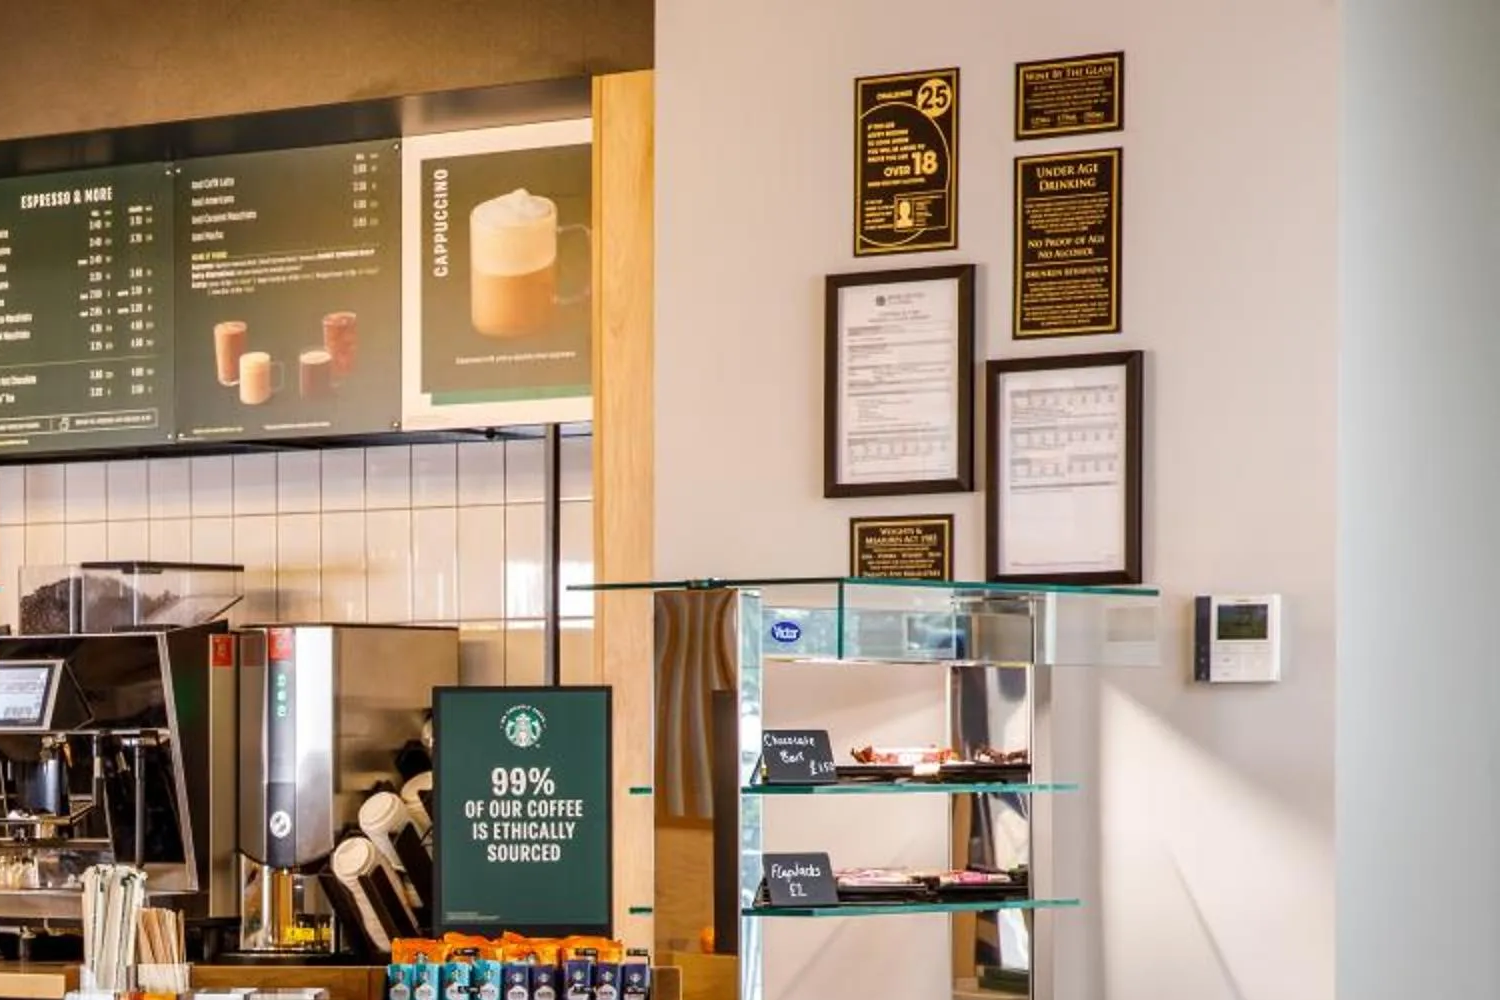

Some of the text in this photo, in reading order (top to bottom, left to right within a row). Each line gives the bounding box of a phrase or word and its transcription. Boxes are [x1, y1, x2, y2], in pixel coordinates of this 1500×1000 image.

[921, 85, 949, 109] 25
[911, 149, 938, 175] 18
[1035, 163, 1098, 178] UNDER AGE
[1039, 177, 1097, 191] DRINKING
[20, 186, 113, 209] ESPRESSO & MORE
[433, 168, 448, 278] CAPPUCCINO
[491, 767, 555, 796] 99%
[465, 799, 583, 818] OF OUR COFFEE
[472, 821, 576, 840] IS ETHICALLY
[487, 843, 561, 862] SOURCED
